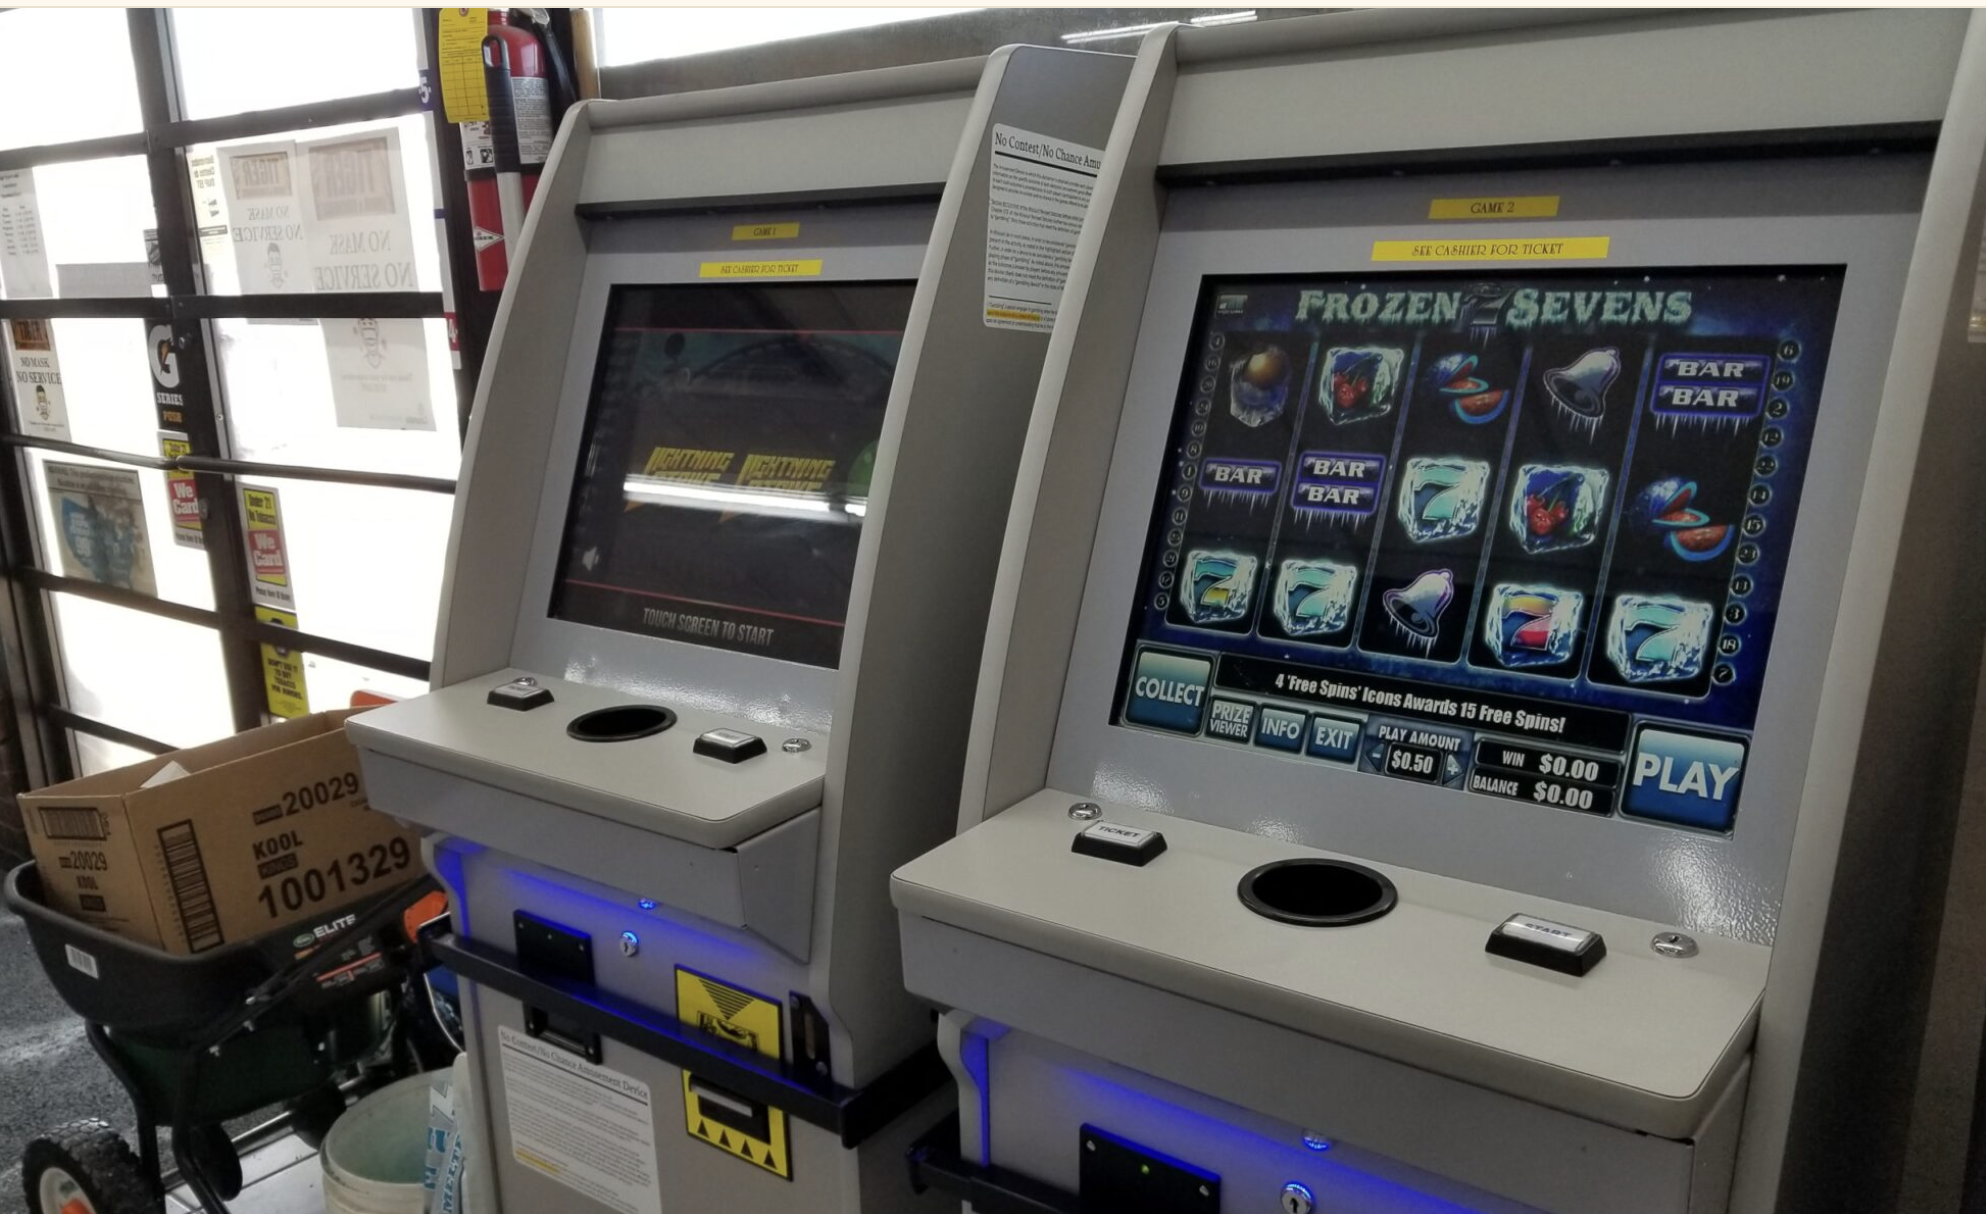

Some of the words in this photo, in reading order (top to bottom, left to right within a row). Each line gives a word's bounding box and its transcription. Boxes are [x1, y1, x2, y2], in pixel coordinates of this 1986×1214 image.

[995, 132, 1008, 147] No
[1008, 136, 1054, 158] Contest/No
[1055, 147, 1083, 166] Chance
[1470, 202, 1505, 215] GAME
[1505, 202, 1516, 214] 2
[1411, 244, 1433, 257] SEE
[1435, 244, 1487, 257] CASHIER
[1489, 243, 1519, 256] FOR
[1521, 242, 1564, 256] TICKET
[776, 263, 800, 273] TICKET
[1294, 289, 1463, 326] FROZEN
[1505, 286, 1693, 329] SEVENS
[20, 357, 31, 368] NO
[30, 357, 50, 368] MASK
[1677, 361, 1746, 377] BAR
[16, 371, 28, 383] NO
[28, 371, 62, 385] SERVICE
[1775, 374, 1791, 386] 19
[157, 392, 183, 406] SERIES
[1671, 388, 1740, 407] BAR
[1764, 431, 1780, 442] 12
[643, 446, 735, 474] LIGHTNING
[738, 454, 836, 483] LIGHTNING
[1312, 460, 1366, 479] BAR
[1214, 466, 1263, 485] BAR
[173, 482, 194, 498] We
[1306, 485, 1361, 505] BAR
[1752, 490, 1766, 501] 14
[172, 498, 200, 515] Card
[1747, 519, 1761, 531] 15
[253, 532, 276, 550] We
[252, 549, 284, 567] Card
[643, 608, 677, 629] TOUCH
[677, 614, 720, 637] SCREEN
[722, 621, 736, 640] TO
[737, 624, 775, 646] START
[1722, 639, 1737, 650] 18
[1135, 676, 1205, 707] COLLECT
[1275, 673, 1285, 688] 4
[1287, 674, 1318, 694] 'Free
[1319, 679, 1362, 701] Spins'
[1363, 686, 1402, 708] Icons
[1403, 693, 1458, 717] Awards
[1459, 701, 1477, 720] 15
[1478, 705, 1512, 725] Free
[1515, 710, 1567, 734] Spins!
[1211, 704, 1251, 724] PRIZE
[1209, 718, 1249, 738] VIEWER
[1260, 717, 1301, 740] INFO
[1314, 726, 1353, 750] EXIT
[1378, 725, 1408, 743] PLAY
[1408, 730, 1461, 752] AMOUNT
[1391, 749, 1434, 775] $0.50
[1501, 750, 1525, 768] WIN
[1538, 752, 1600, 783] $0.00
[1632, 750, 1740, 801] PLAY
[282, 771, 359, 817] 20029
[1472, 774, 1519, 797] BALANCE
[1533, 780, 1594, 810] $0.00
[1098, 825, 1142, 838] TICKET
[252, 829, 303, 861] KOOL
[70, 851, 108, 871] 20029
[76, 875, 99, 890] KOOL
[258, 836, 411, 919] 1001329
[313, 913, 356, 938] ELITE
[1524, 923, 1573, 937] START
[500, 1030, 512, 1043] No
[511, 1035, 551, 1060] Contest/No
[551, 1051, 577, 1071] Chance
[577, 1064, 622, 1088] Amusement
[622, 1081, 649, 1099] Device
